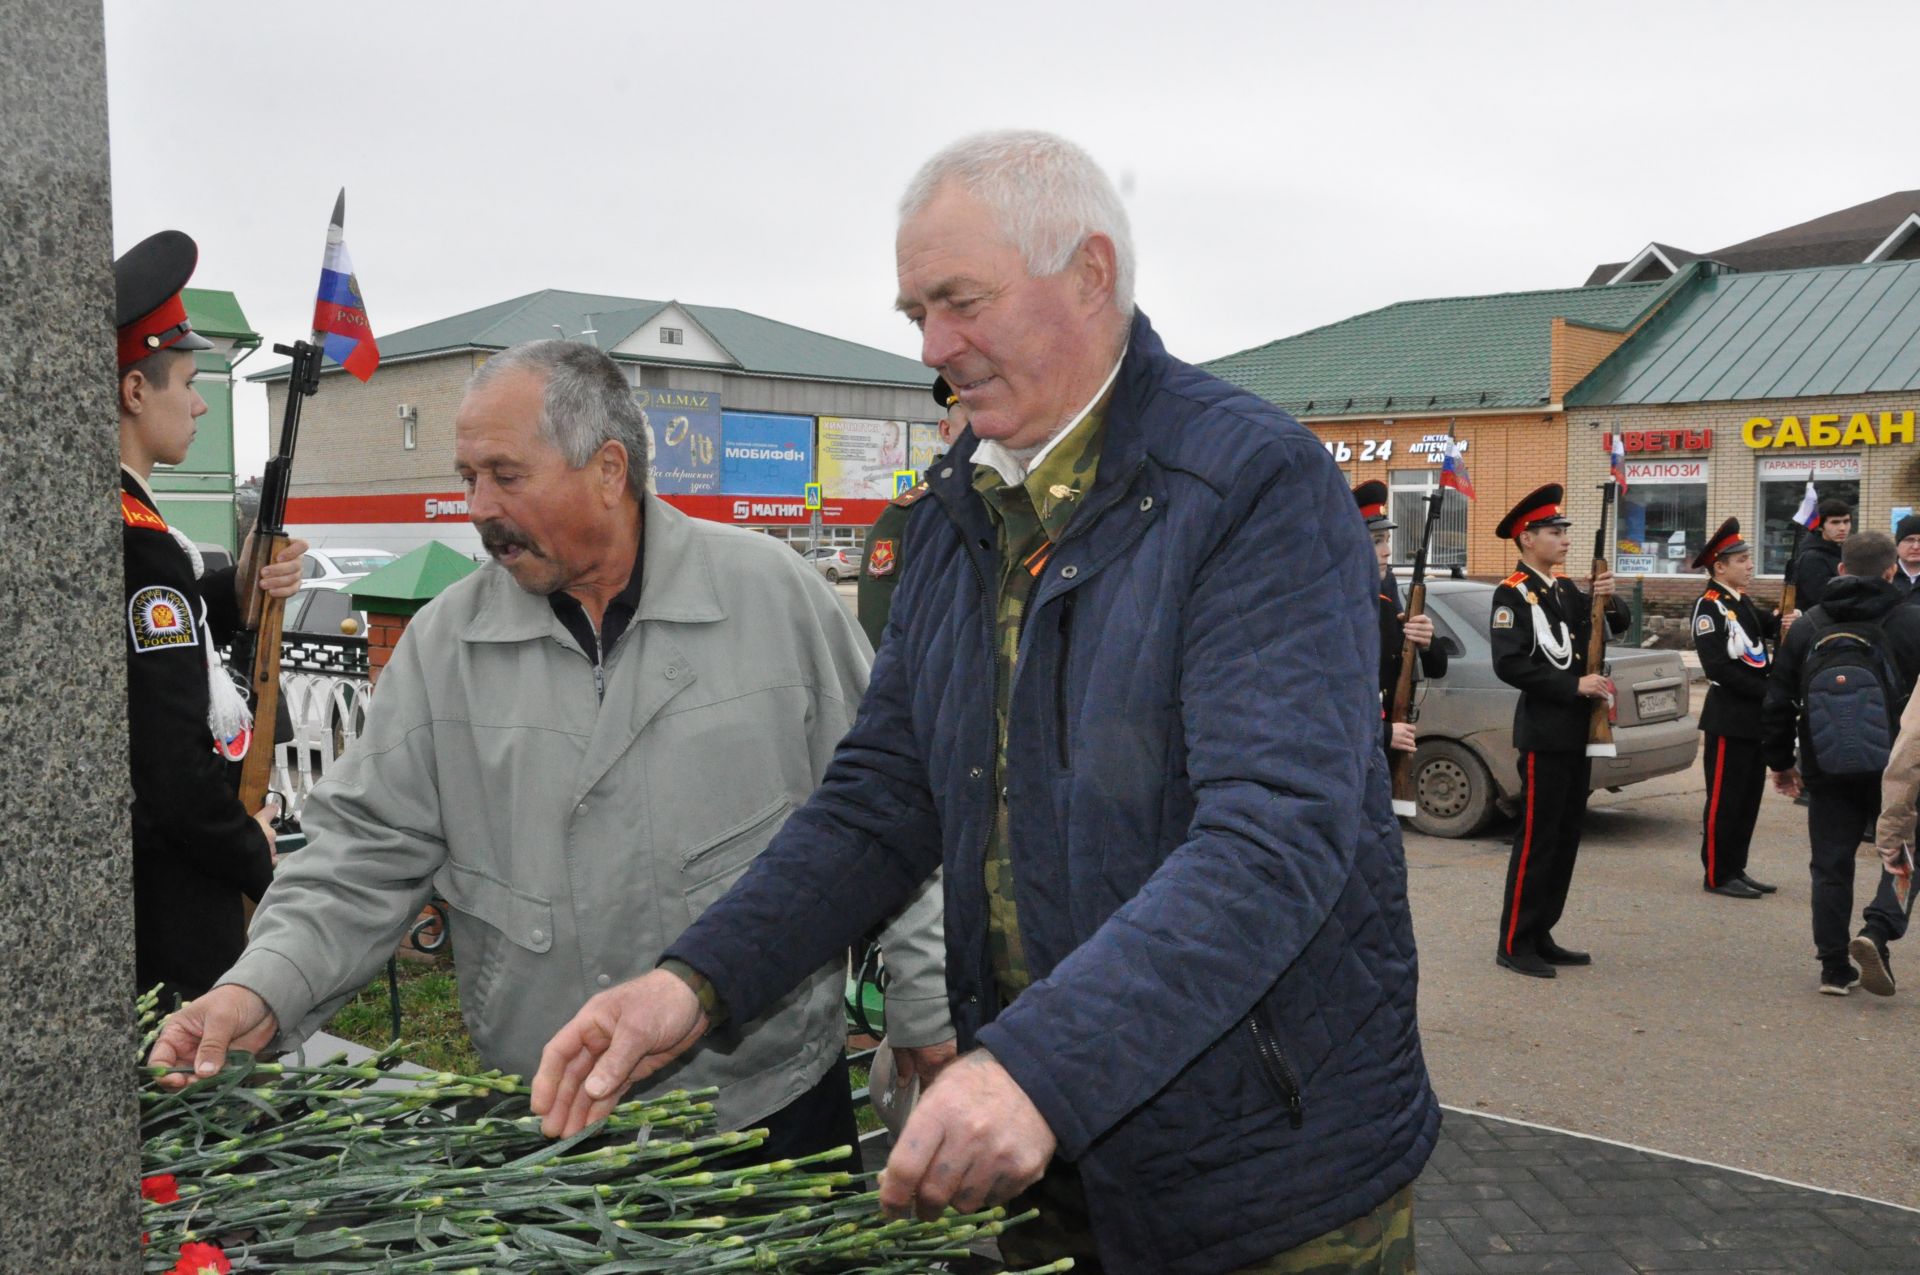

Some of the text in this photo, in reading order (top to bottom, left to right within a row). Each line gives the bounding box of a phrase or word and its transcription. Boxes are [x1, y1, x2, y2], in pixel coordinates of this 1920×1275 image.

[656, 394, 708, 406] ALMAZ
[1741, 410, 1915, 448] САБАН
[725, 447, 804, 461] МОБИФОН
[1360, 439, 1392, 462] 24
[1627, 463, 1701, 477] ЖАЛЮЗИ
[1764, 458, 1859, 470] ГАРАЖНЫЕ ВОРОТА
[751, 503, 805, 517] МАГНИТ
[1619, 558, 1652, 566] ПЕЧАТИ
[143, 634, 191, 648] РОССИИ
